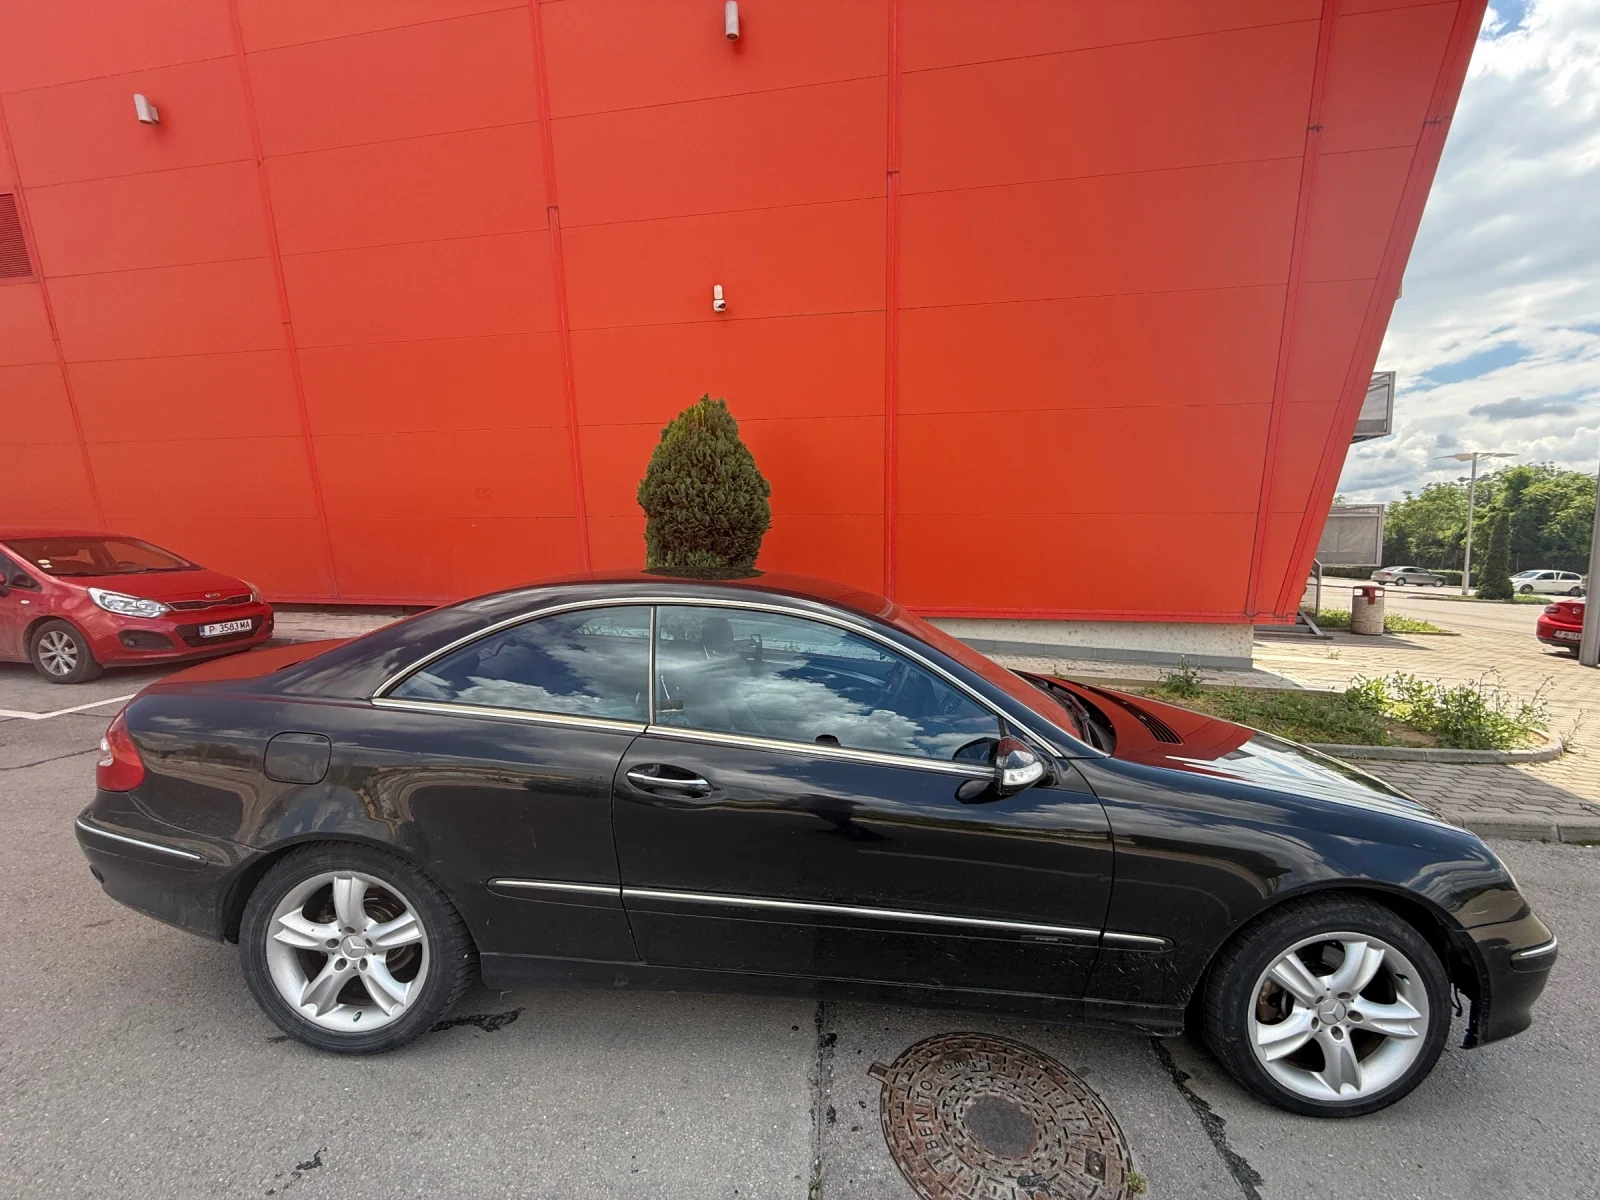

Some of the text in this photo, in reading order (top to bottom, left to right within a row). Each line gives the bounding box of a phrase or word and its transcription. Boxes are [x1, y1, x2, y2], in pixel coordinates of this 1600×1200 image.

[209, 625, 215, 634] P
[219, 622, 239, 632] 3583
[240, 620, 250, 629] MA
